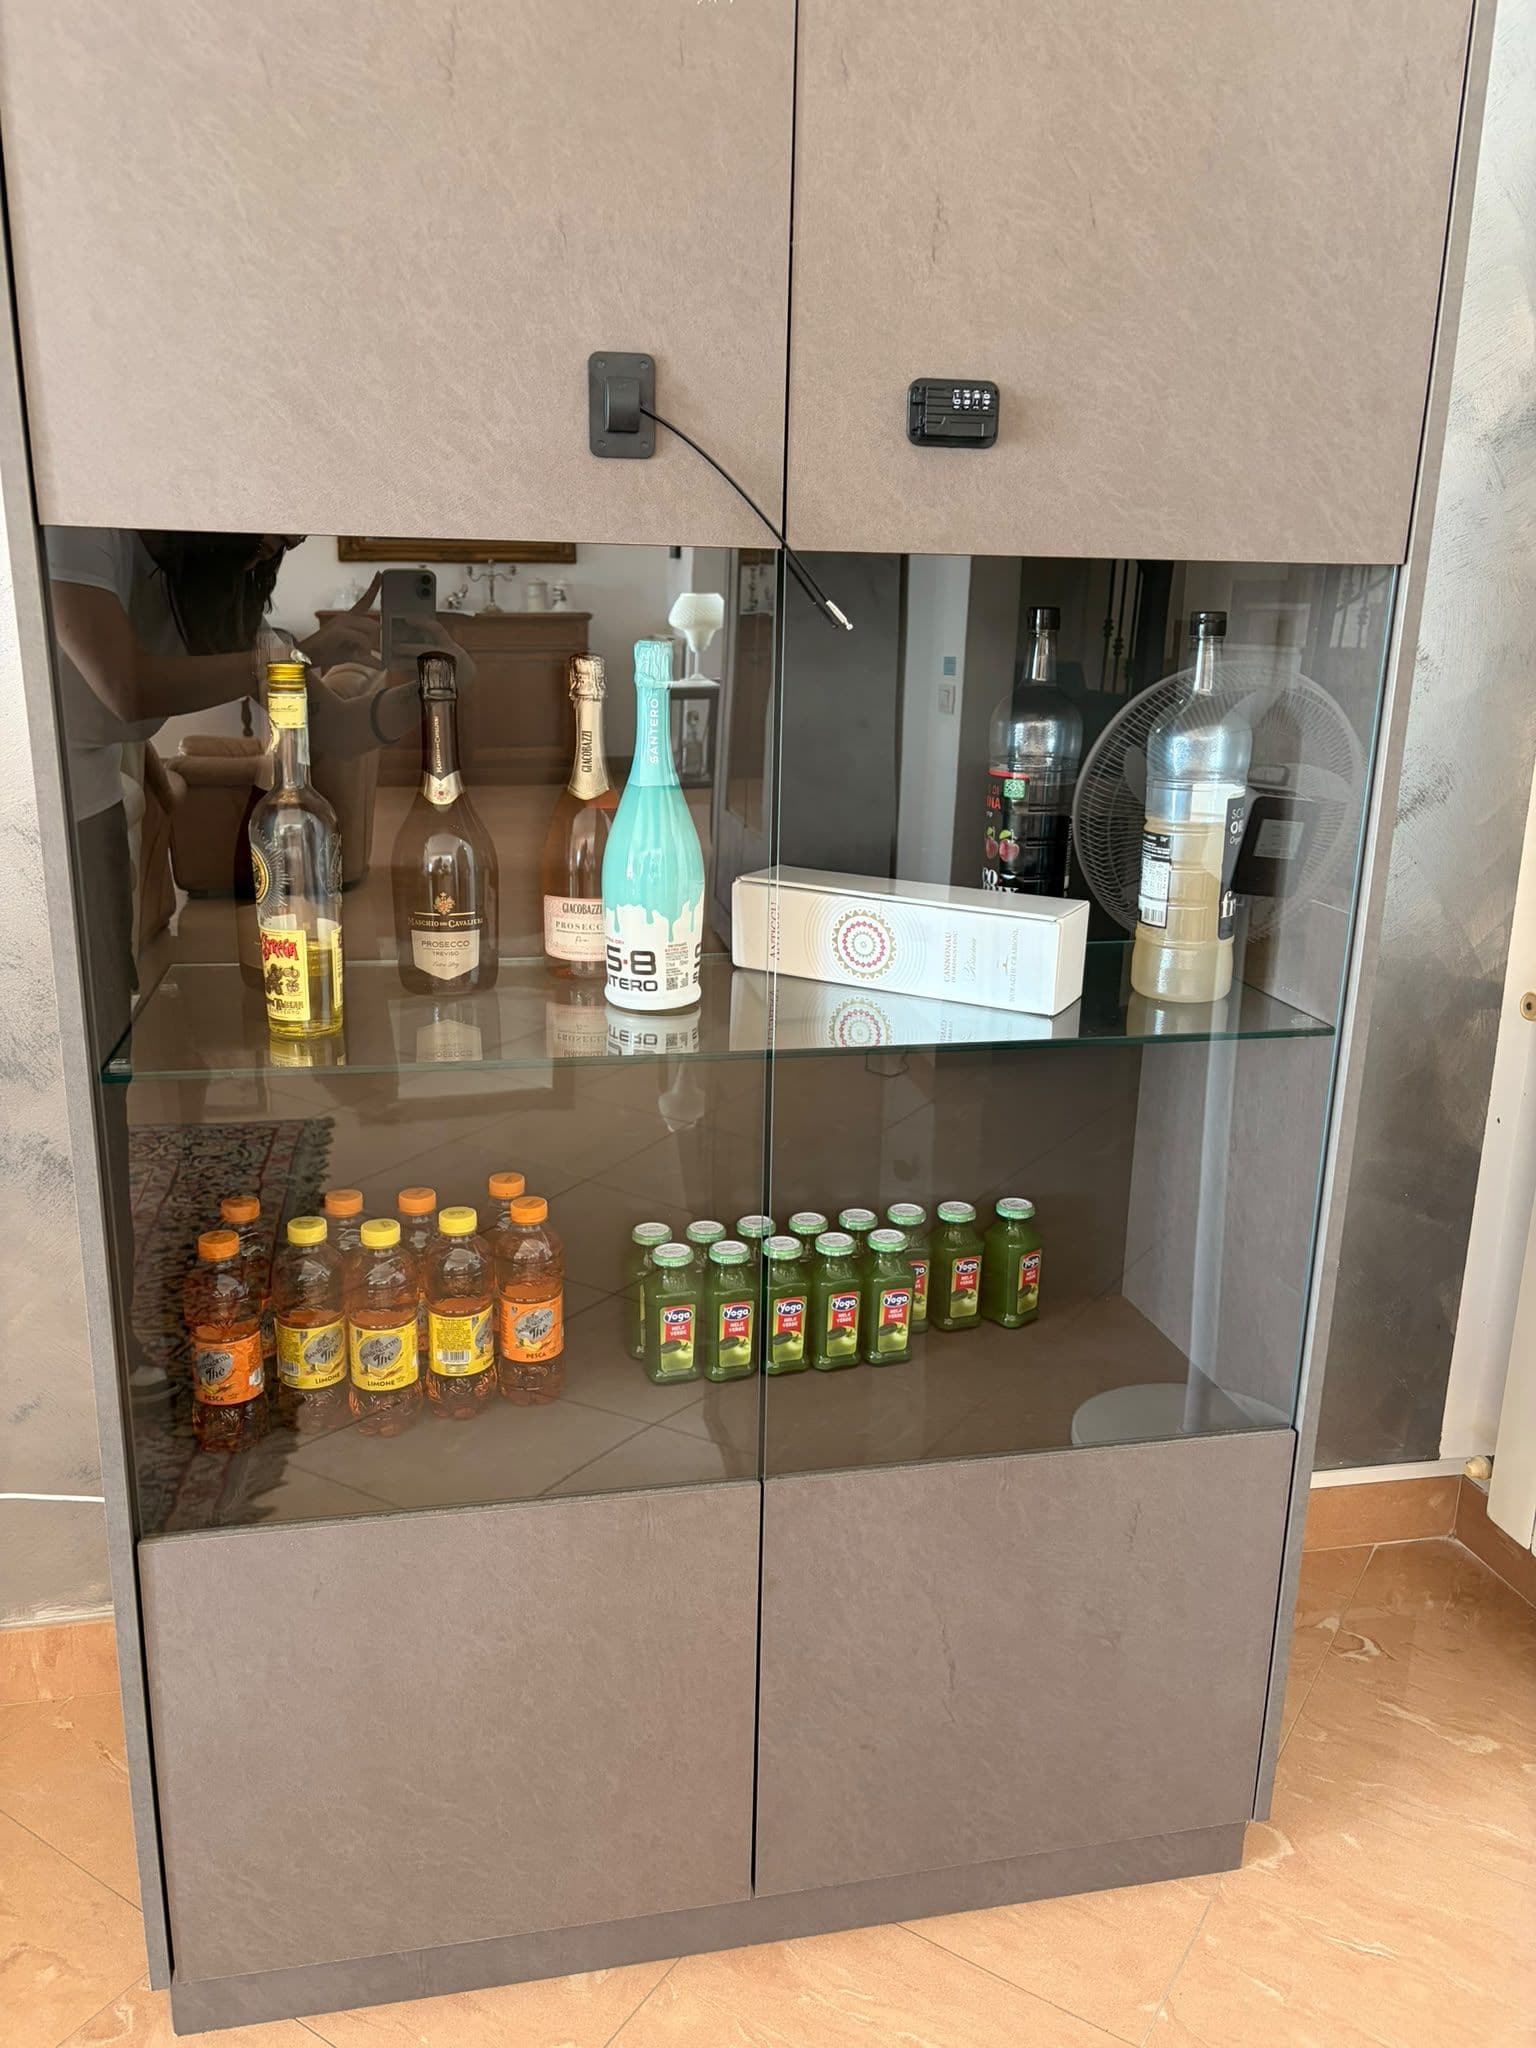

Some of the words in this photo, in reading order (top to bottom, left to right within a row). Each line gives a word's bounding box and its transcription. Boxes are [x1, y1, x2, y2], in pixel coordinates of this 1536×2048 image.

[650, 697, 659, 766] SANTERO
[582, 730, 592, 773] GIACOBAZZI
[421, 940, 470, 948] PROSECCO
[957, 1262, 978, 1272] Yoga
[833, 1298, 856, 1309] Yoga
[885, 1294, 908, 1305] Yoga
[724, 1307, 749, 1319] Yoga
[778, 1303, 802, 1314] Yoga
[664, 1311, 690, 1322] Yoga
[315, 1372, 340, 1384] LIMONE
[204, 1394, 224, 1402] PESCA
